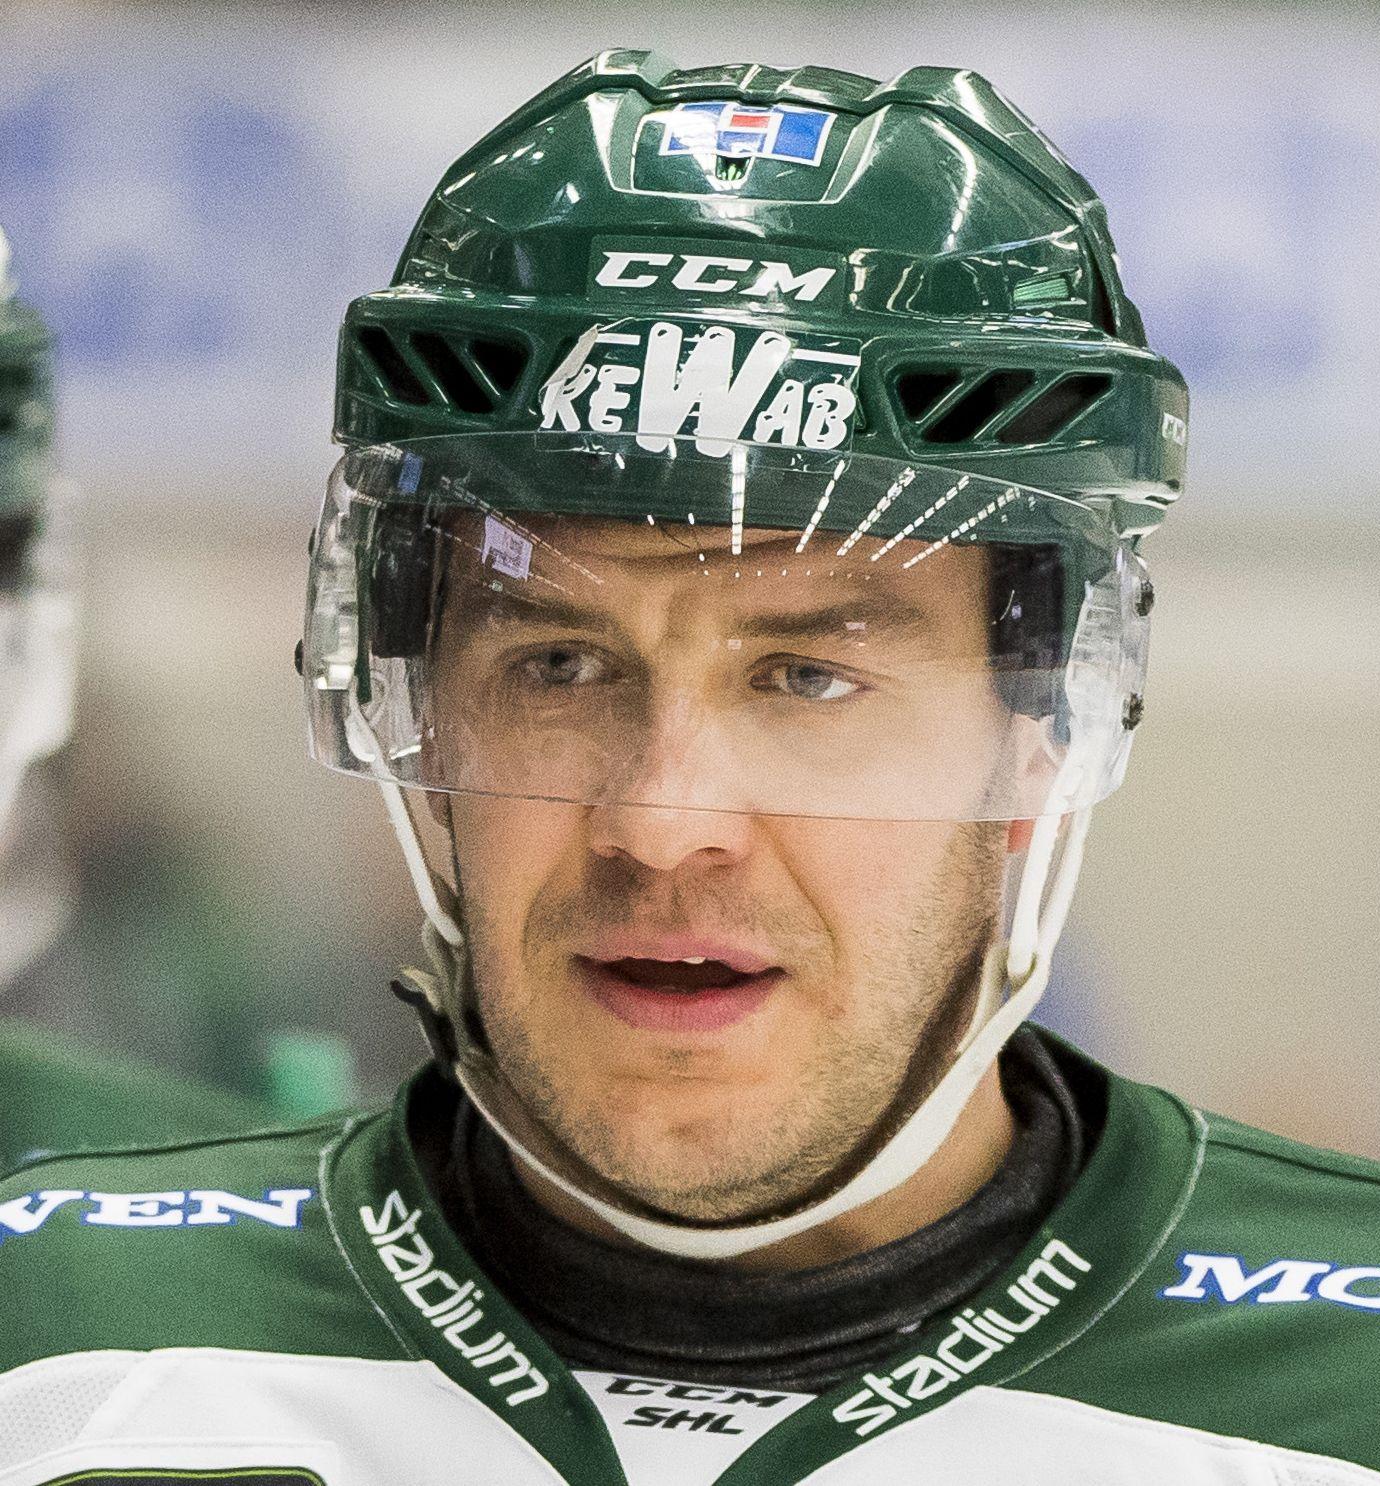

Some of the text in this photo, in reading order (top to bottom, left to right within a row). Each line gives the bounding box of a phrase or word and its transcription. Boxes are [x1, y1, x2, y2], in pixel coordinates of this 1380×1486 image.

[595, 251, 837, 301] CCM
[359, 1189, 549, 1407] stadium
[832, 1238, 1092, 1437] stadium
[604, 1376, 788, 1408] CCM
[622, 1406, 744, 1435] SHL
